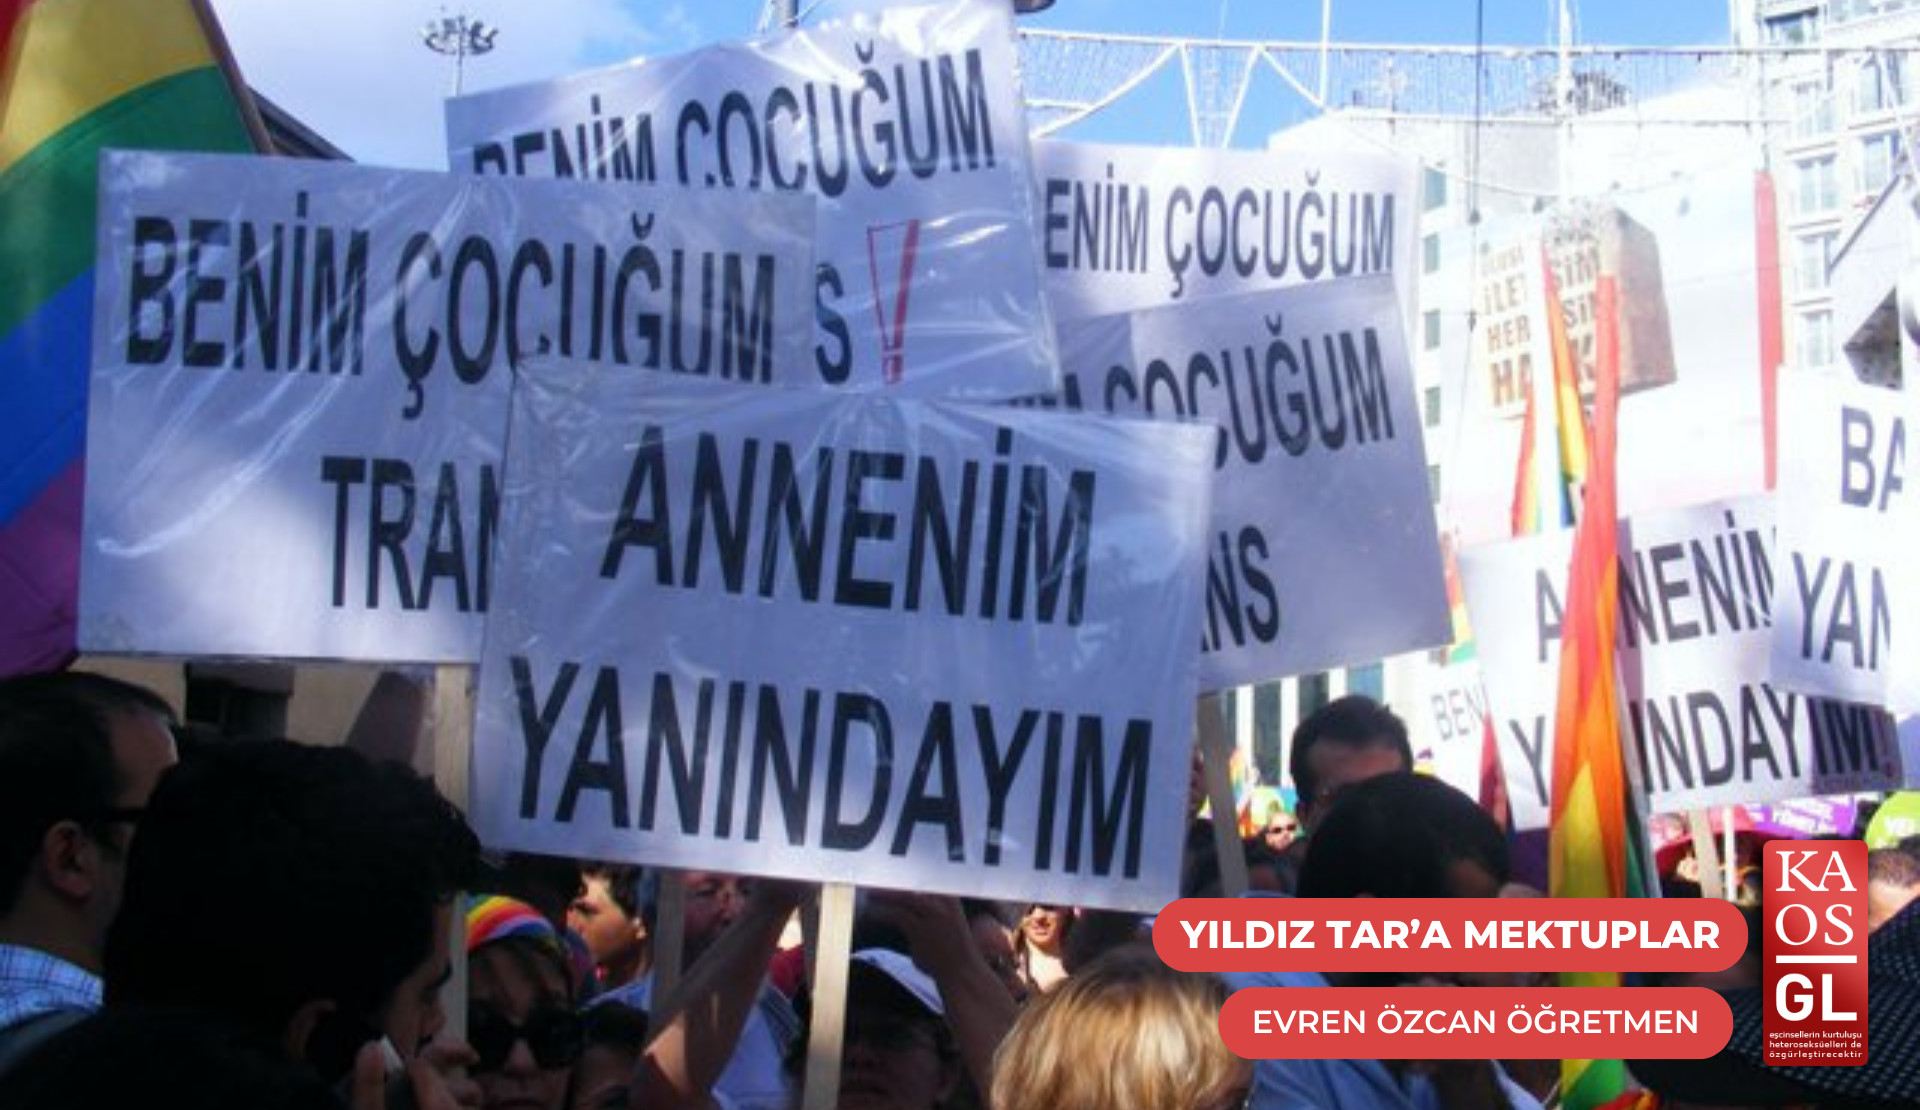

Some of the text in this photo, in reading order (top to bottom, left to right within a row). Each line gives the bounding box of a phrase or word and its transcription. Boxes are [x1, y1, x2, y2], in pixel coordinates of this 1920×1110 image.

[125, 191, 776, 419] BENİM ÇOCUĞUM
[1163, 169, 1394, 299] ÇOCUĞUM
[600, 425, 1097, 627] ANNENİM
[508, 655, 1153, 880] YANINDAYIM
